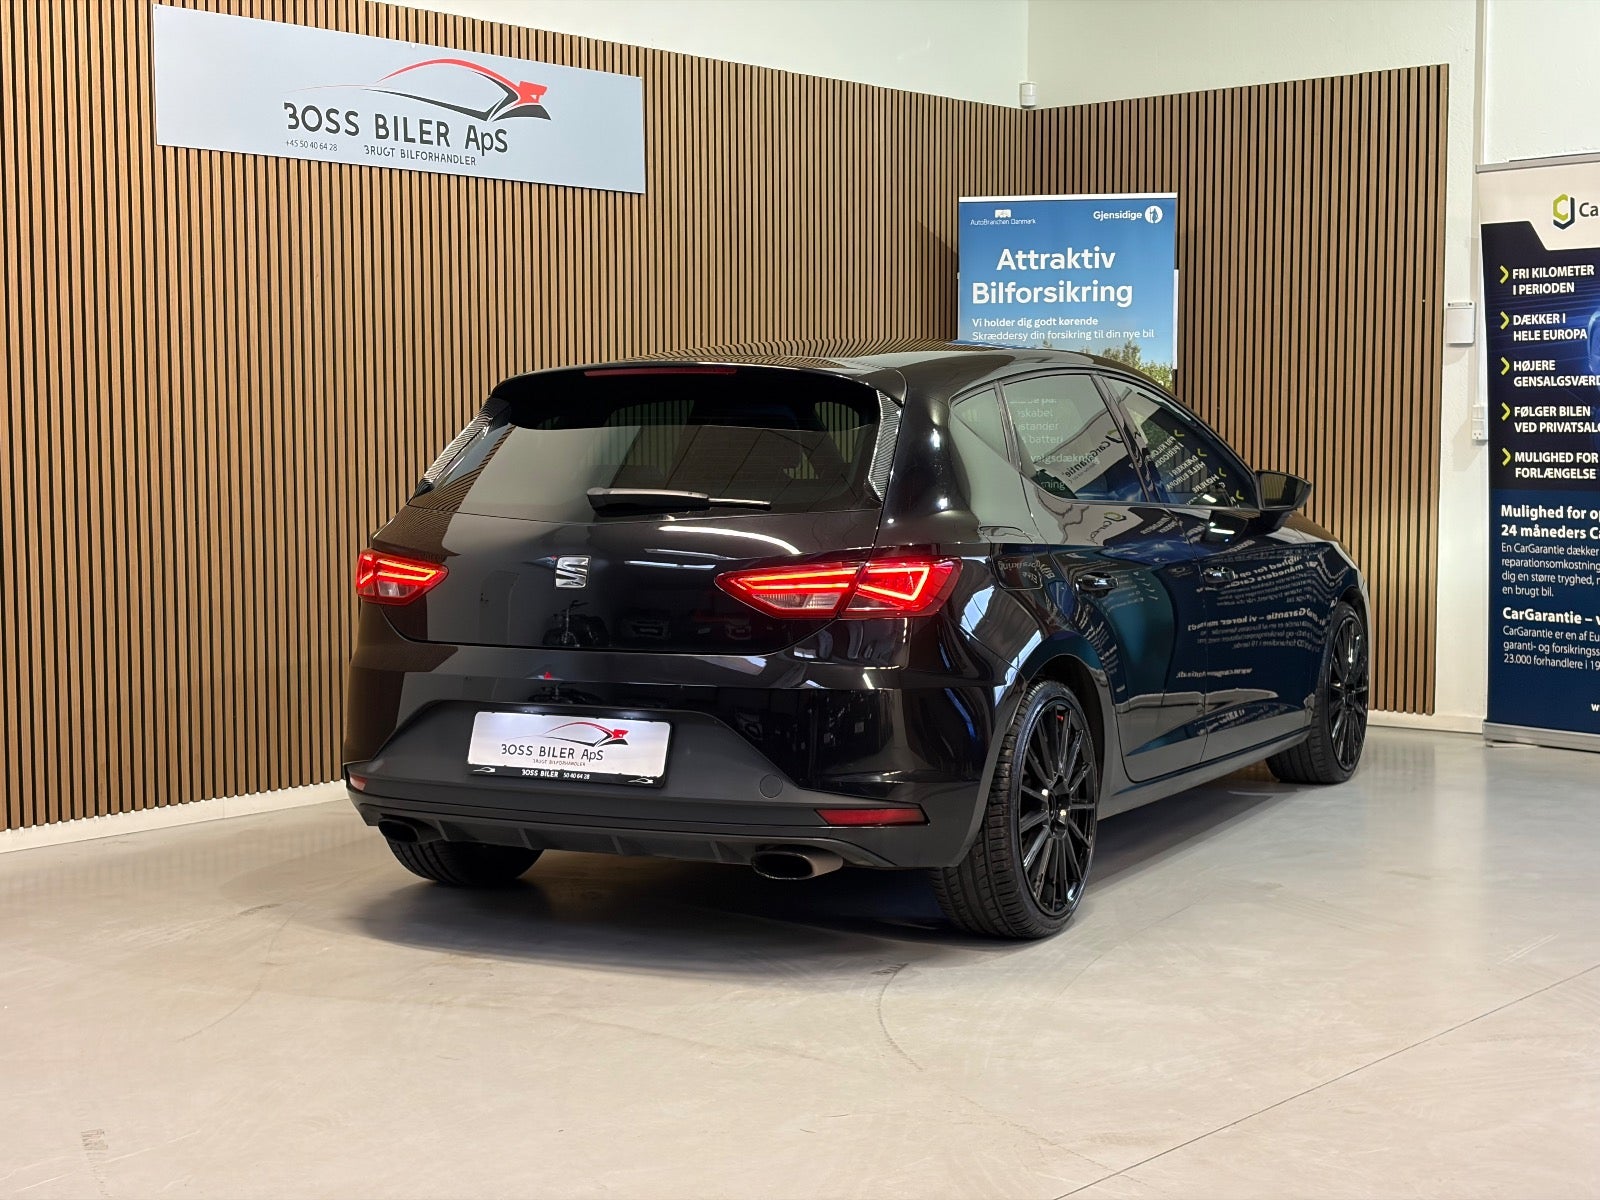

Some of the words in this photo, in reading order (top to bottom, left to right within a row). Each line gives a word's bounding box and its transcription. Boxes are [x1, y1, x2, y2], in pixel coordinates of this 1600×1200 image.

[375, 114, 451, 147] BILER
[464, 124, 508, 156] ApS
[300, 140, 308, 150] 50
[310, 142, 318, 150] 40
[319, 142, 328, 151] 64
[328, 143, 338, 152] 28
[400, 149, 476, 166] BILFORHANDLER
[1093, 210, 1143, 221] Gjensidige
[996, 246, 1116, 270] Attraktiv
[1513, 268, 1529, 279] FRI
[1532, 265, 1595, 279] KILOMETER
[972, 280, 1133, 308] Bilforsikring
[1518, 282, 1575, 295] PERIODEN
[972, 318, 982, 327] Vi
[984, 318, 1015, 327] holder
[1017, 318, 1032, 329] dig
[1034, 317, 1057, 328] godt
[1058, 316, 1099, 326] kørende
[1514, 314, 1560, 325] DÆKKER
[972, 331, 1028, 341] Skræddersy
[1030, 330, 1045, 339] din
[1048, 330, 1092, 341] forsikring
[1094, 329, 1104, 338] til
[1106, 329, 1121, 338] din
[1123, 330, 1140, 340] nye
[1143, 328, 1154, 338] bil
[1514, 330, 1540, 341] HELE
[1544, 328, 1588, 340] EUROPA
[1514, 360, 1556, 371] HØJERE
[1514, 406, 1556, 418] FØLGER
[1559, 406, 1590, 416] BILEN
[1514, 422, 1536, 432] VED
[1514, 452, 1574, 463] MULIGHED
[1576, 452, 1599, 463] FOR
[1515, 468, 1597, 479] FORLÆNGELSE
[1501, 504, 1564, 521] Mulighed
[1566, 506, 1586, 519] for
[1501, 524, 1517, 536] 24
[1520, 524, 1586, 539] måneders
[1502, 542, 1512, 552] En
[1514, 543, 1564, 554] CarGarantie
[1566, 545, 1599, 557] dækker
[1502, 571, 1516, 583] dig
[1518, 574, 1529, 582] en
[1532, 573, 1556, 582] større
[1558, 574, 1594, 586] tryghed,
[1502, 586, 1513, 594] en
[1515, 585, 1540, 598] brugt
[1541, 586, 1554, 597] bil.
[1502, 606, 1582, 624] CarGarantie
[1502, 625, 1553, 638] CarGarantie
[1554, 630, 1564, 639] er
[1566, 632, 1576, 640] en
[1578, 630, 1588, 641] af
[1504, 640, 1536, 652] garanti-
[1538, 644, 1550, 654] og
[1504, 654, 1532, 664] 23.000
[1533, 655, 1584, 669] forhandlere
[538, 747, 576, 760] BILER
[581, 749, 604, 762] ApS
[540, 770, 559, 778] BILER
